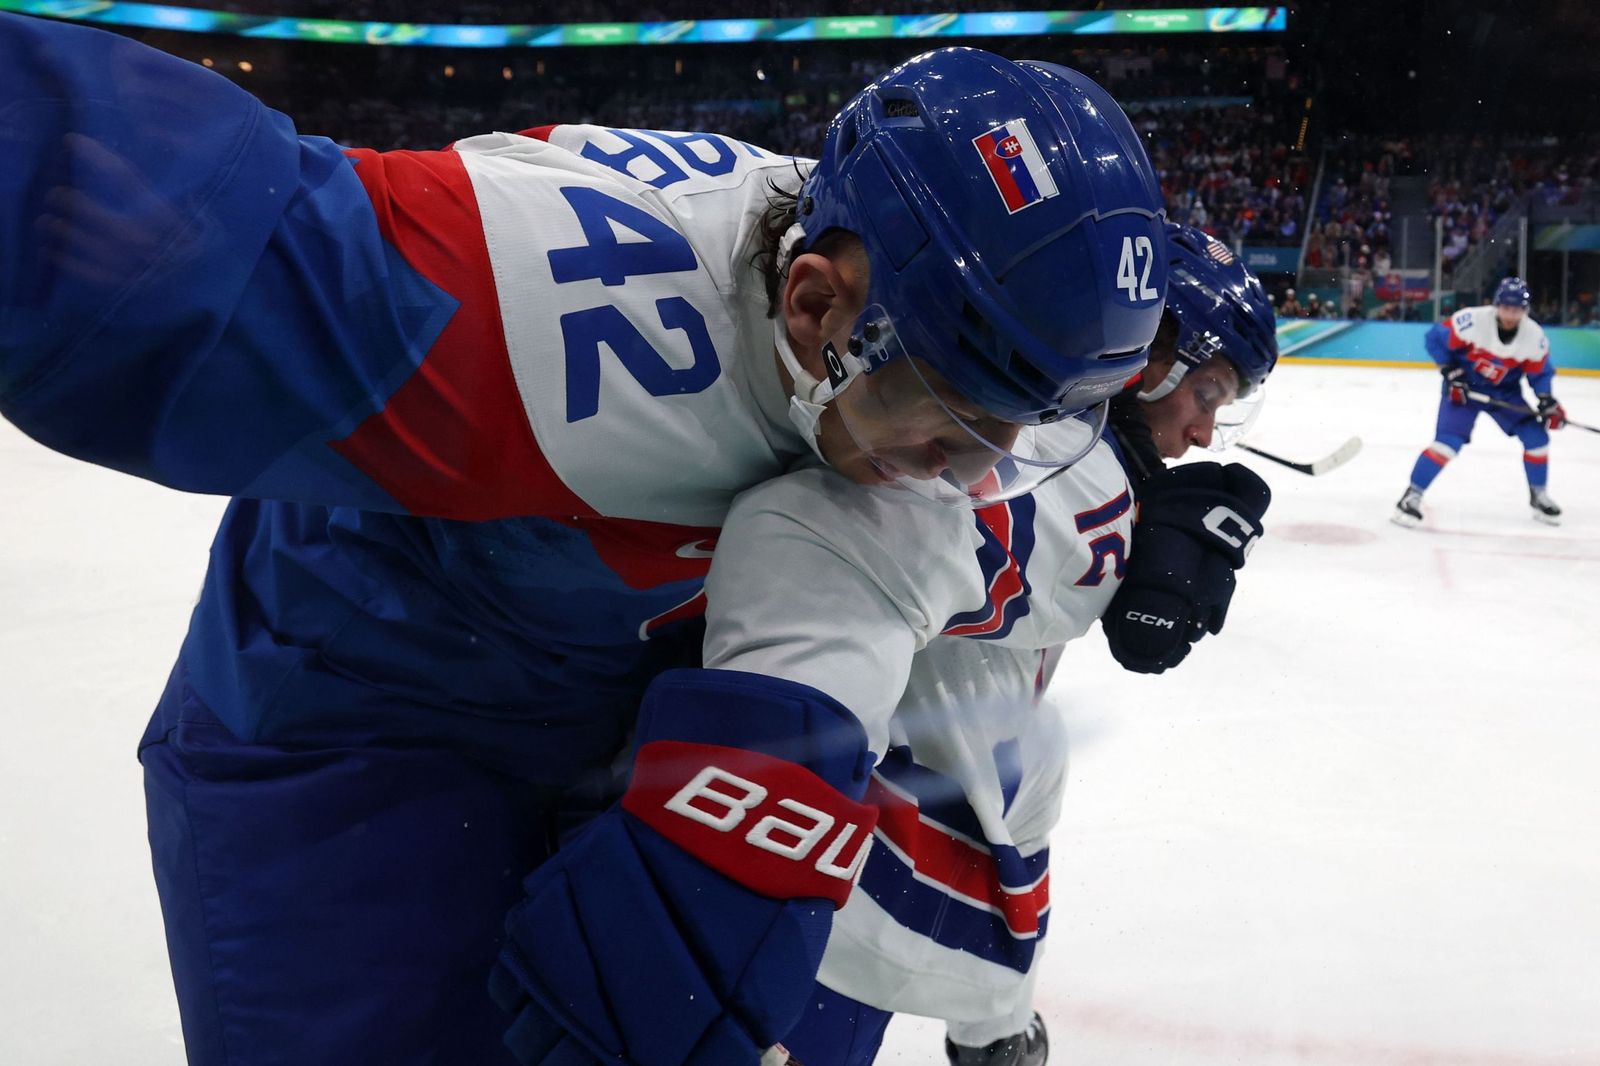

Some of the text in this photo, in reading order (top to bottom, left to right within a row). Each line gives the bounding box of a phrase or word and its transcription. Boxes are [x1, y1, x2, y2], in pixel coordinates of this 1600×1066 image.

[547, 187, 721, 423] 42
[1117, 236, 1158, 301] 42
[1126, 611, 1174, 629] CCM
[663, 766, 873, 886] Bau
